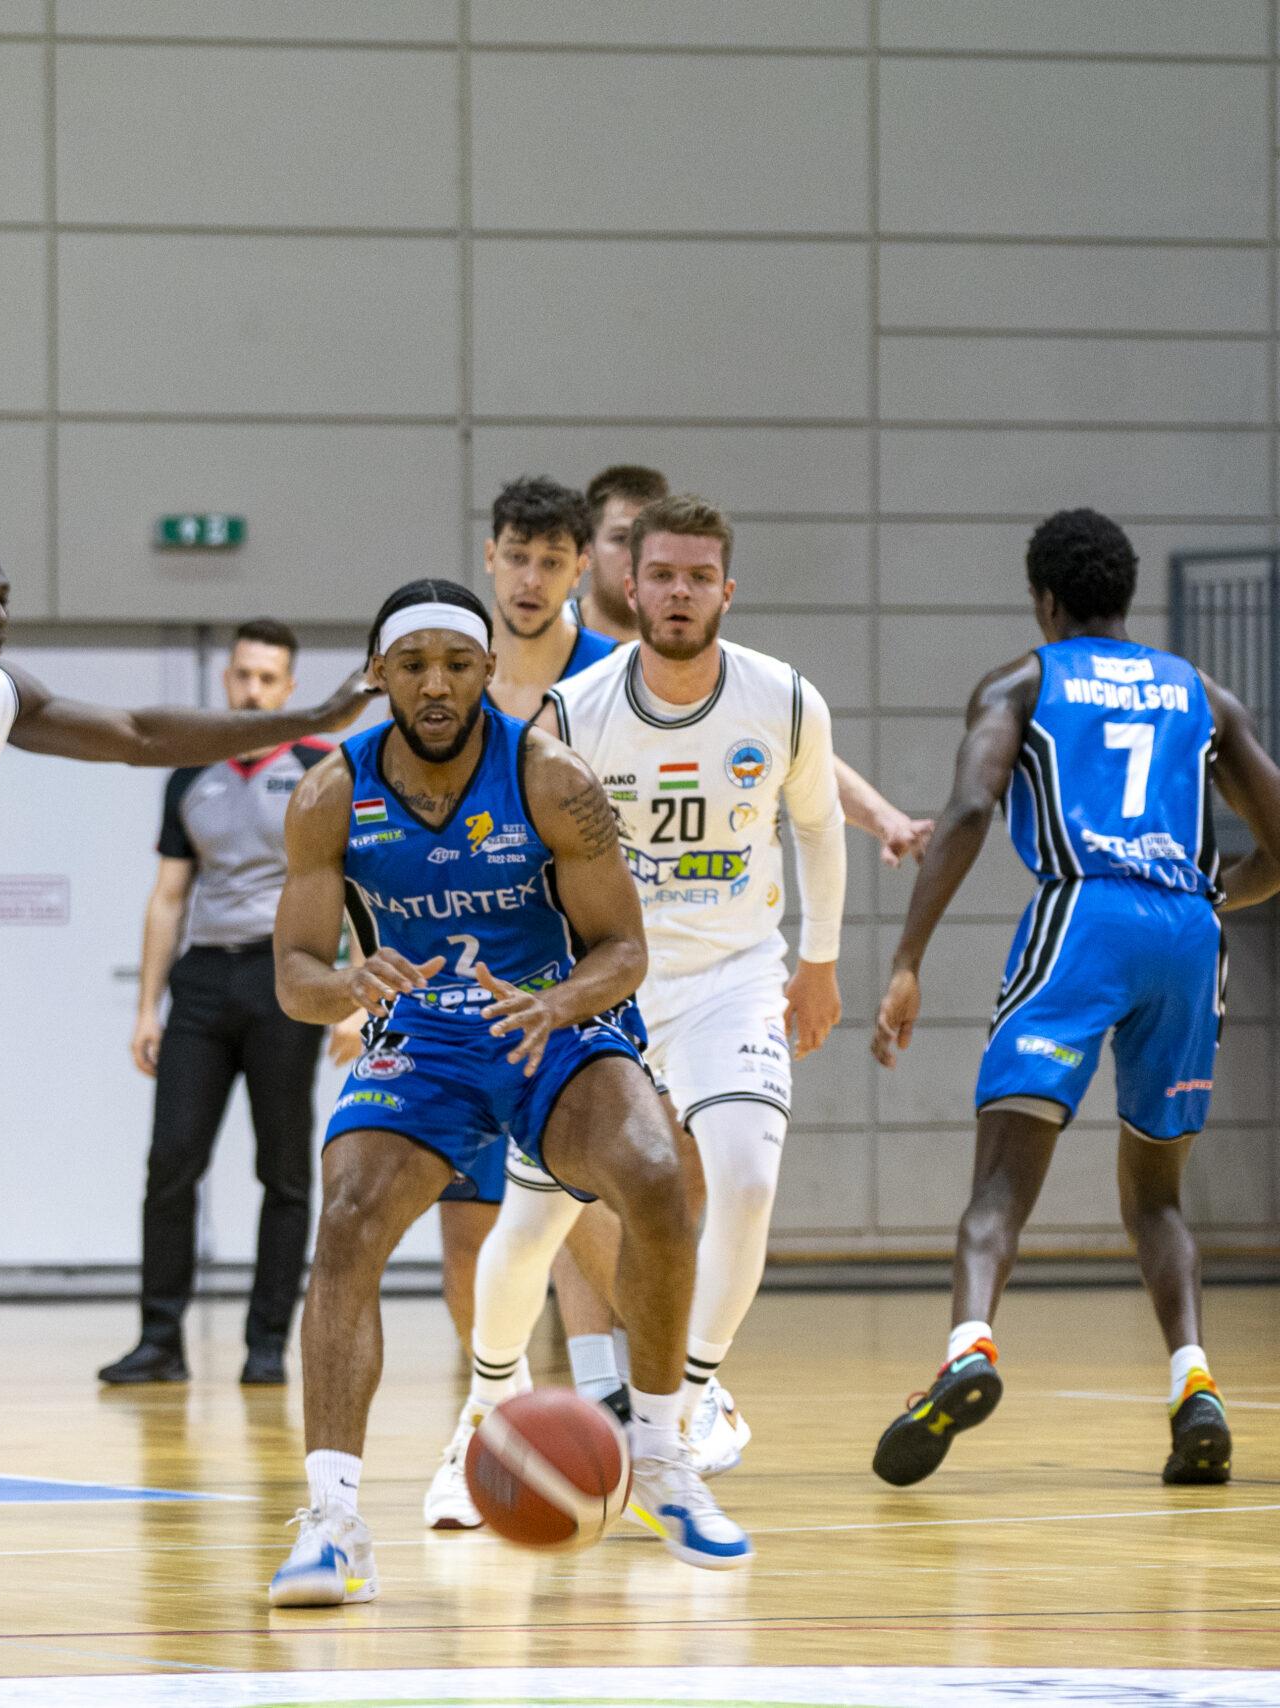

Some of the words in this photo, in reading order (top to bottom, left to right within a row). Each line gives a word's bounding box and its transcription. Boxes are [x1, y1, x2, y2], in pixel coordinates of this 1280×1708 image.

[1064, 677, 1189, 714] NICHOLSON
[1104, 721, 1155, 818] 7
[650, 797, 706, 843] 20
[360, 876, 537, 920] NATURTEX
[446, 934, 480, 978] 2
[738, 1044, 781, 1061] ALAN
